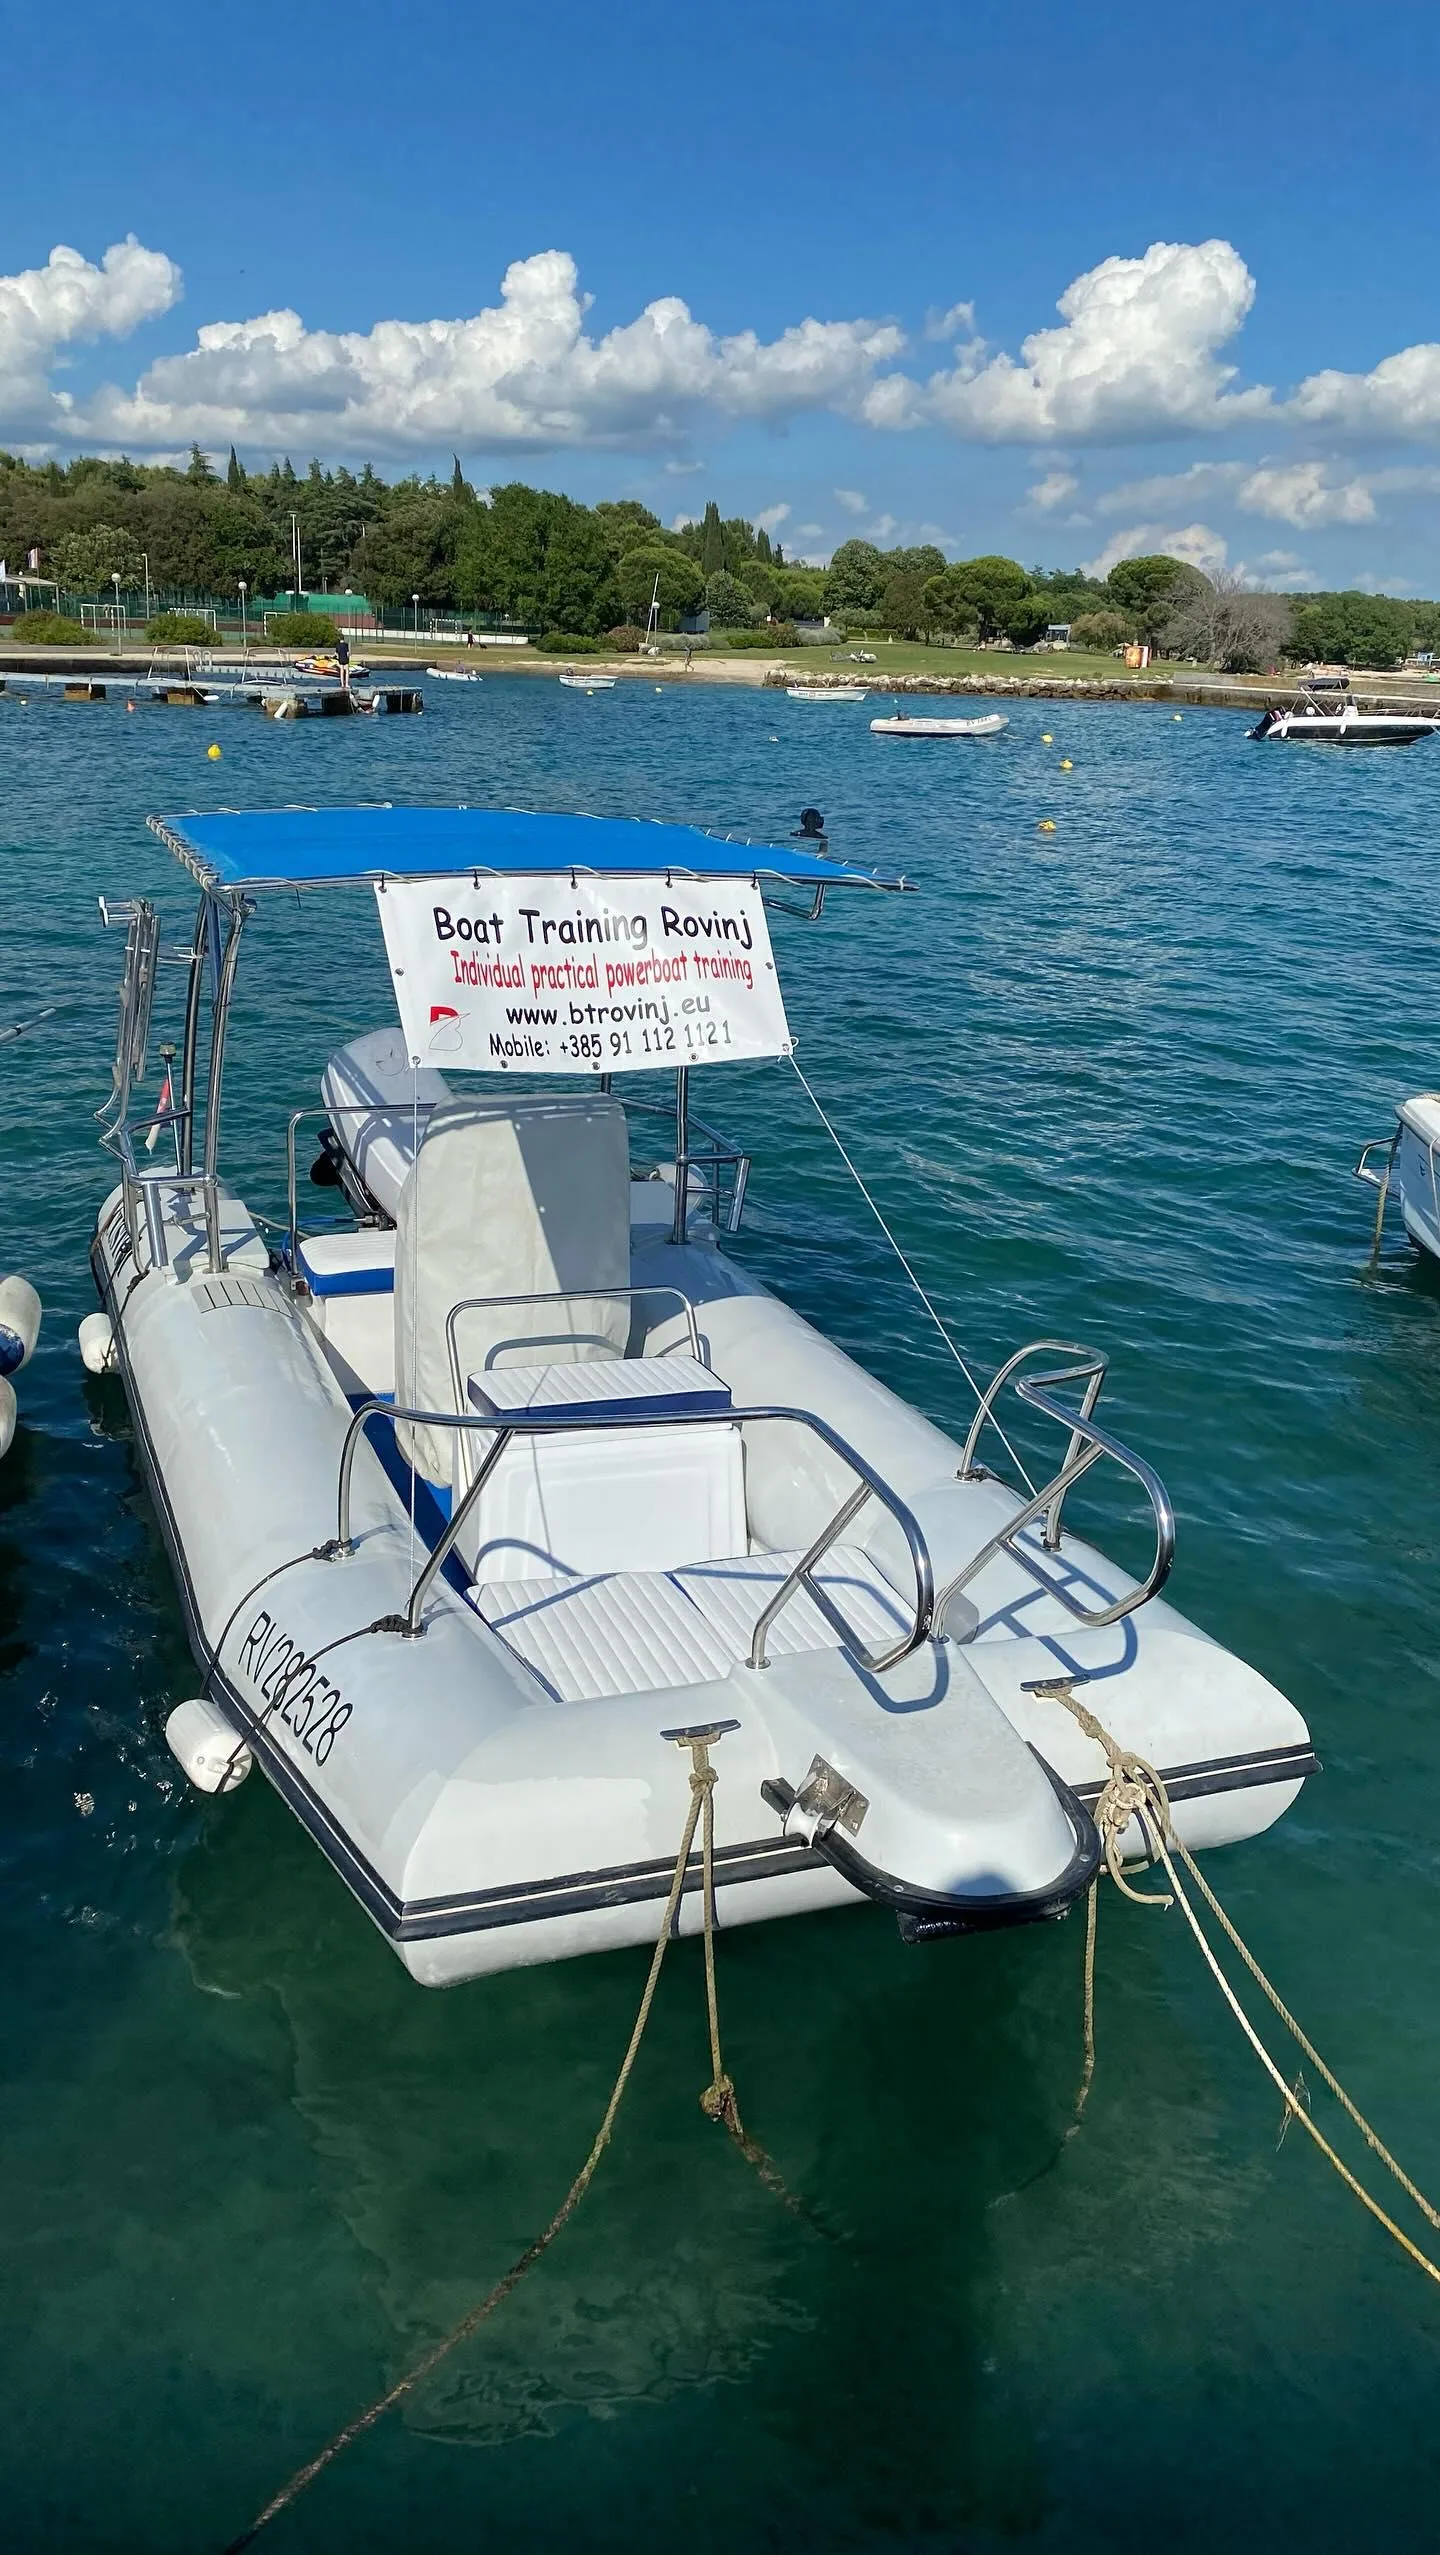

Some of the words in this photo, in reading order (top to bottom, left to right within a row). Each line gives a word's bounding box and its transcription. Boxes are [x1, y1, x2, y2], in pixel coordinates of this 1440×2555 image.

[433, 906, 504, 944] Boat
[518, 908, 648, 951] Training
[661, 905, 753, 950] Rovinj
[450, 950, 526, 988] Individual
[531, 953, 600, 1000] practical
[605, 948, 688, 998] powerboat
[693, 950, 754, 989] training
[506, 995, 711, 1025] www.btrovinj.eu
[489, 1033, 551, 1058] Mobile:
[560, 1033, 602, 1058] +385
[610, 1030, 633, 1057] 91
[643, 1027, 677, 1053] 112
[684, 1020, 732, 1048] 1121
